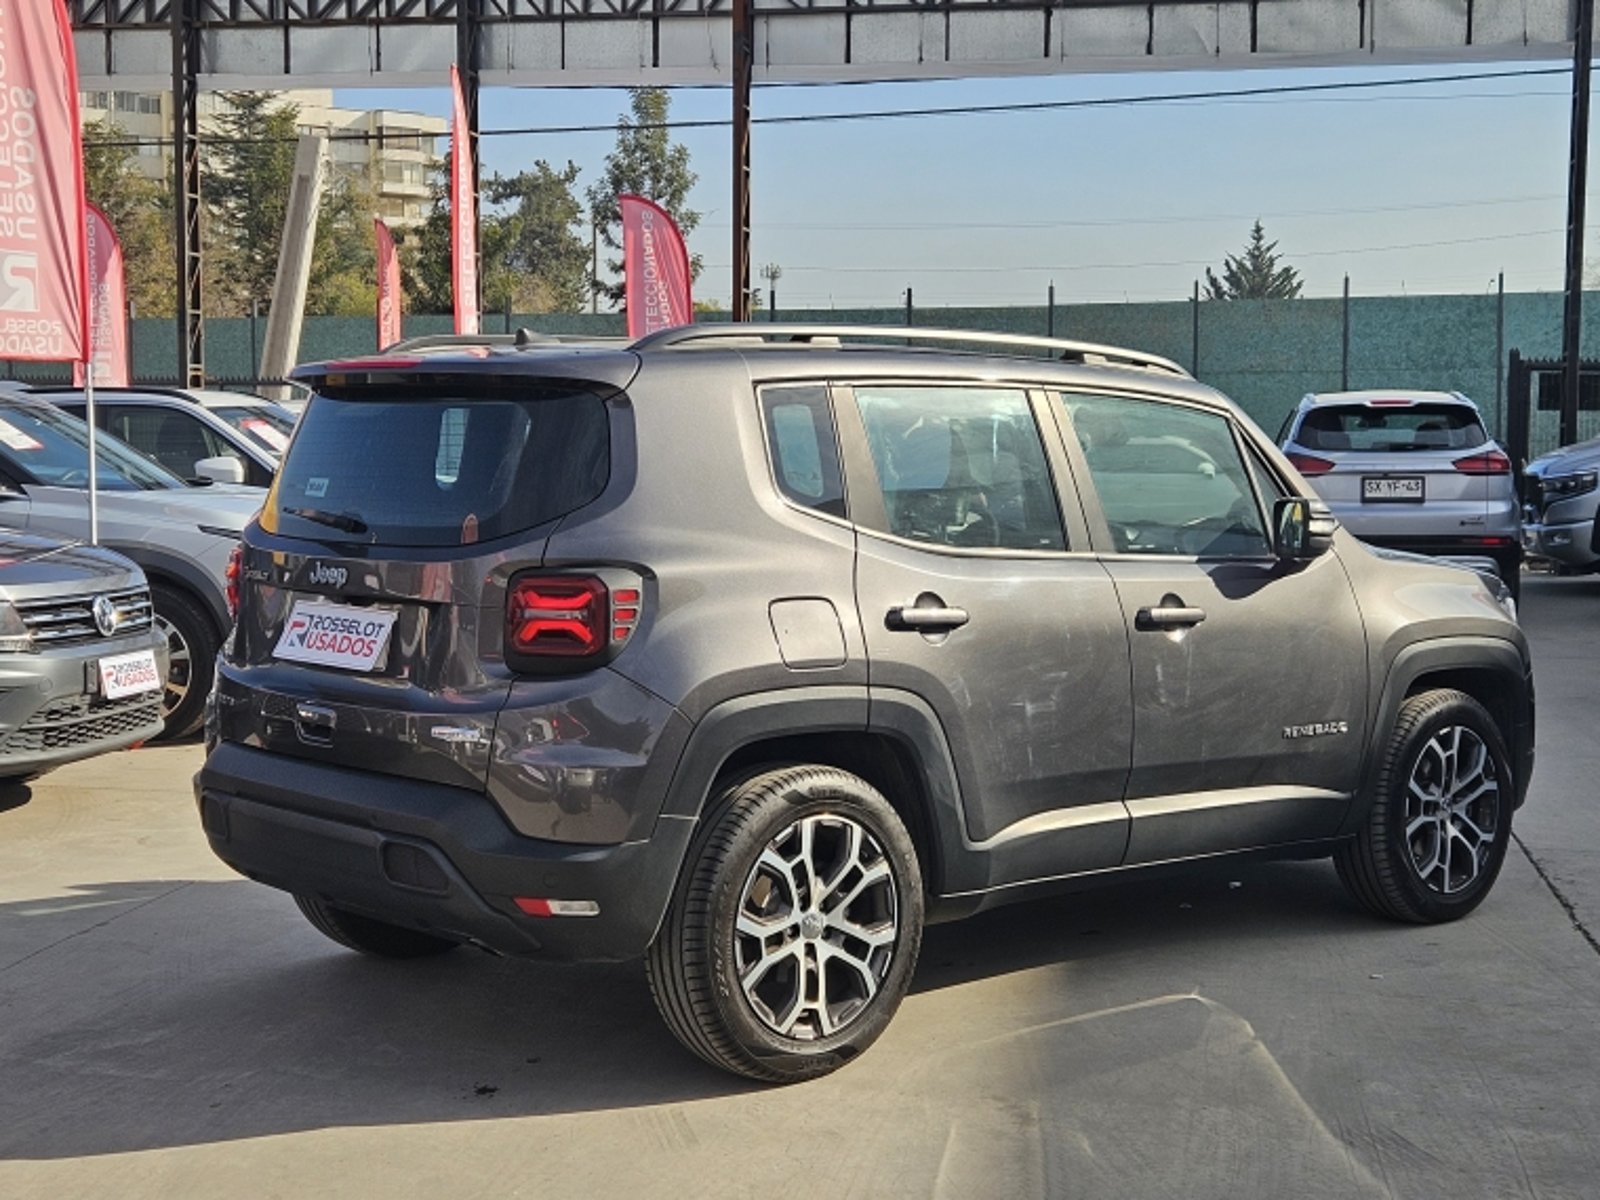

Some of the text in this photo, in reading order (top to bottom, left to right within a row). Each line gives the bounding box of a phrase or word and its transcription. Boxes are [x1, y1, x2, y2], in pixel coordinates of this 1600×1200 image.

[309, 561, 348, 588] Jeep
[313, 615, 385, 638] ROSSELOT
[306, 631, 377, 658] USADOS
